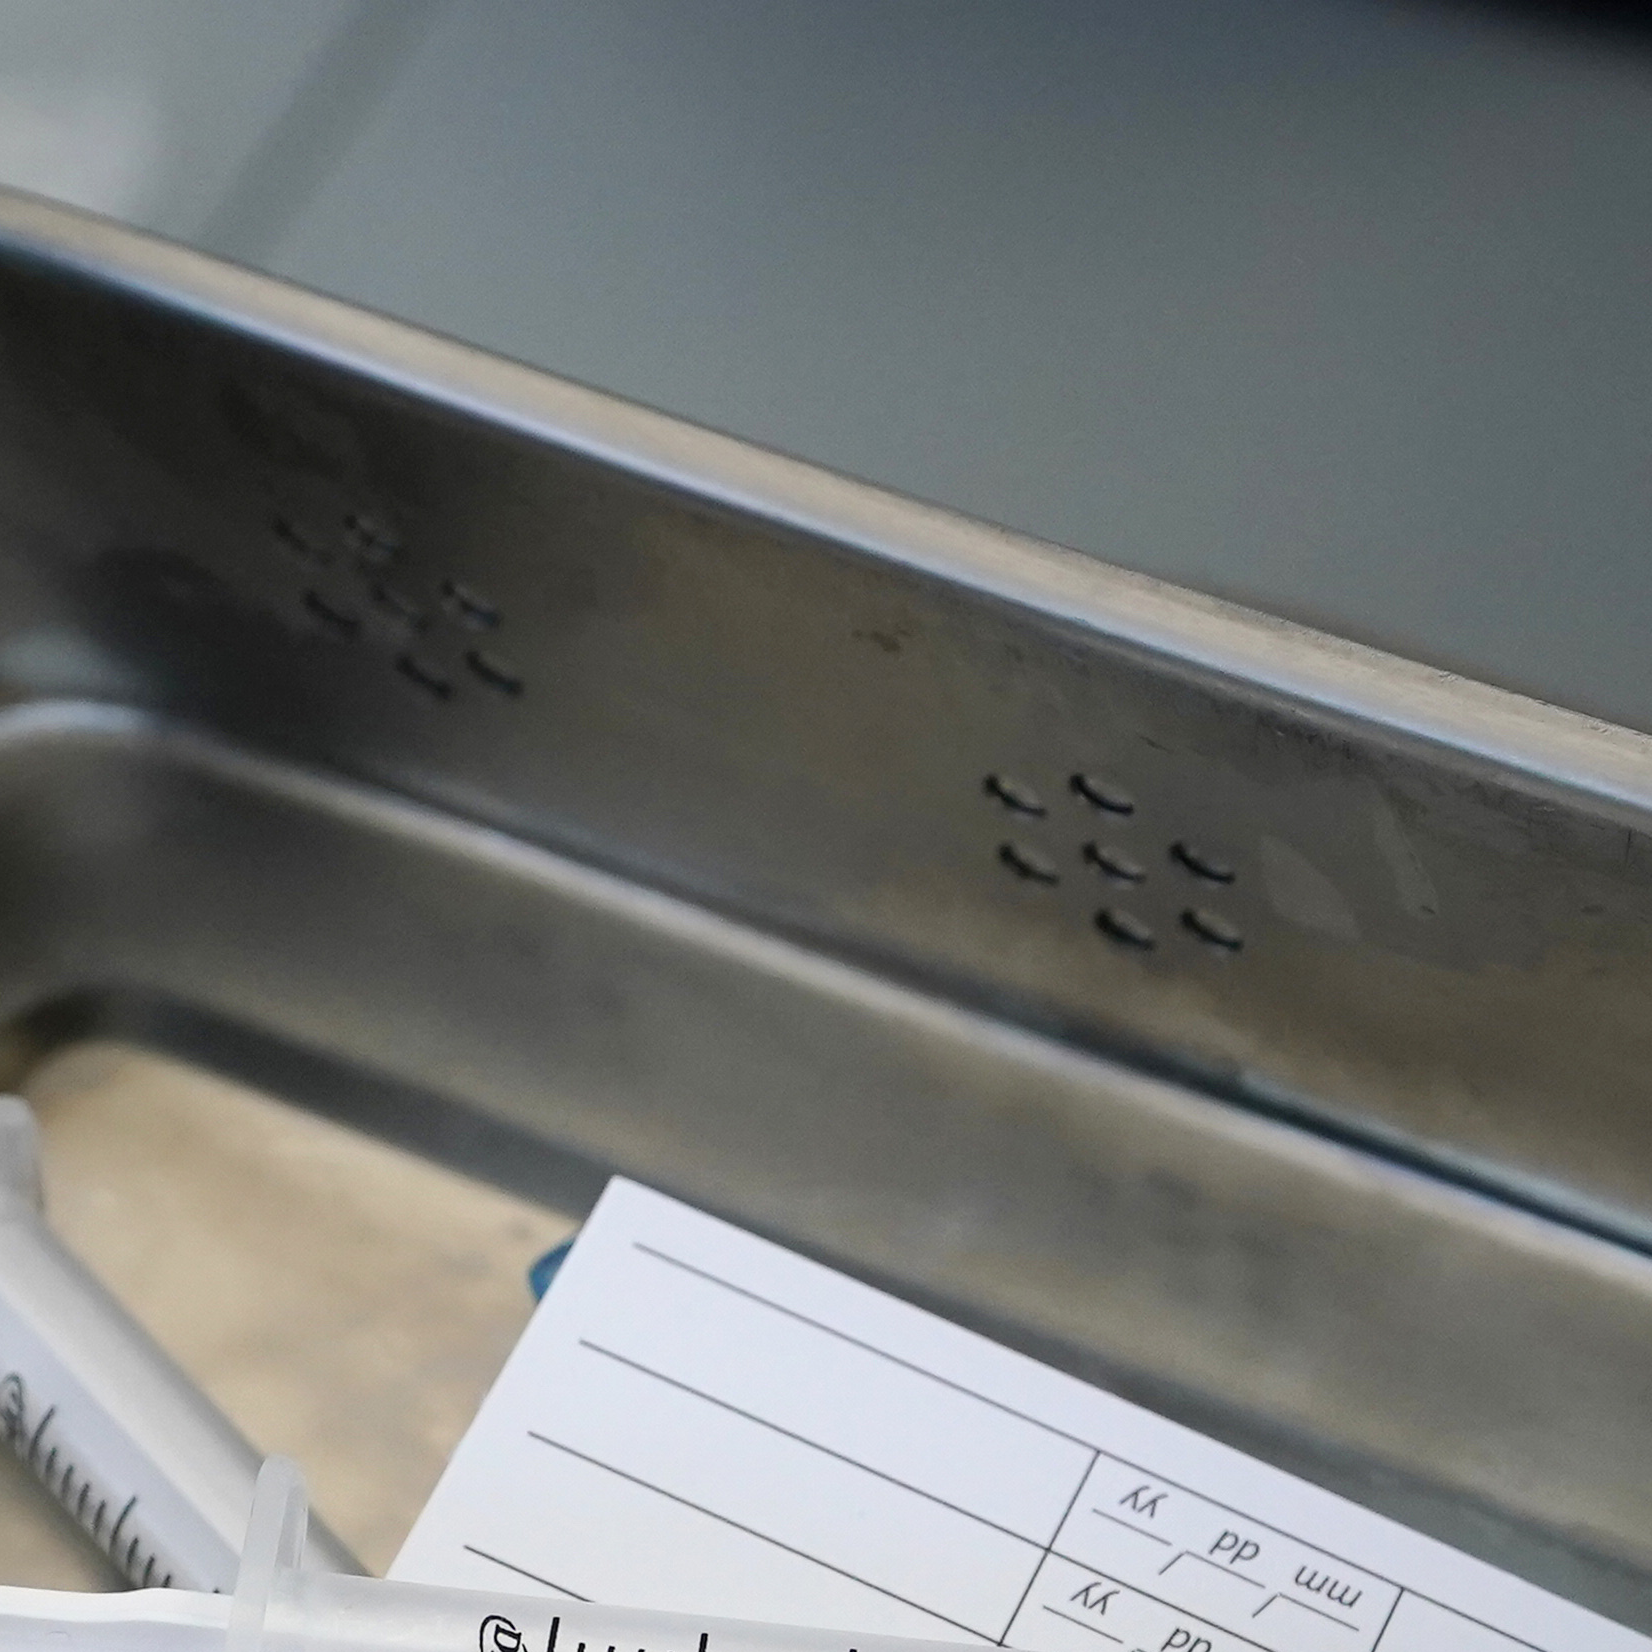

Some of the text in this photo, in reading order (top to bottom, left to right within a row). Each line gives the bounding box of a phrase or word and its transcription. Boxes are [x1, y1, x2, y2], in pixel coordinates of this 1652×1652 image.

[1120, 1486, 1362, 1608] mm dd yy
[1071, 1583, 1119, 1615] yy
